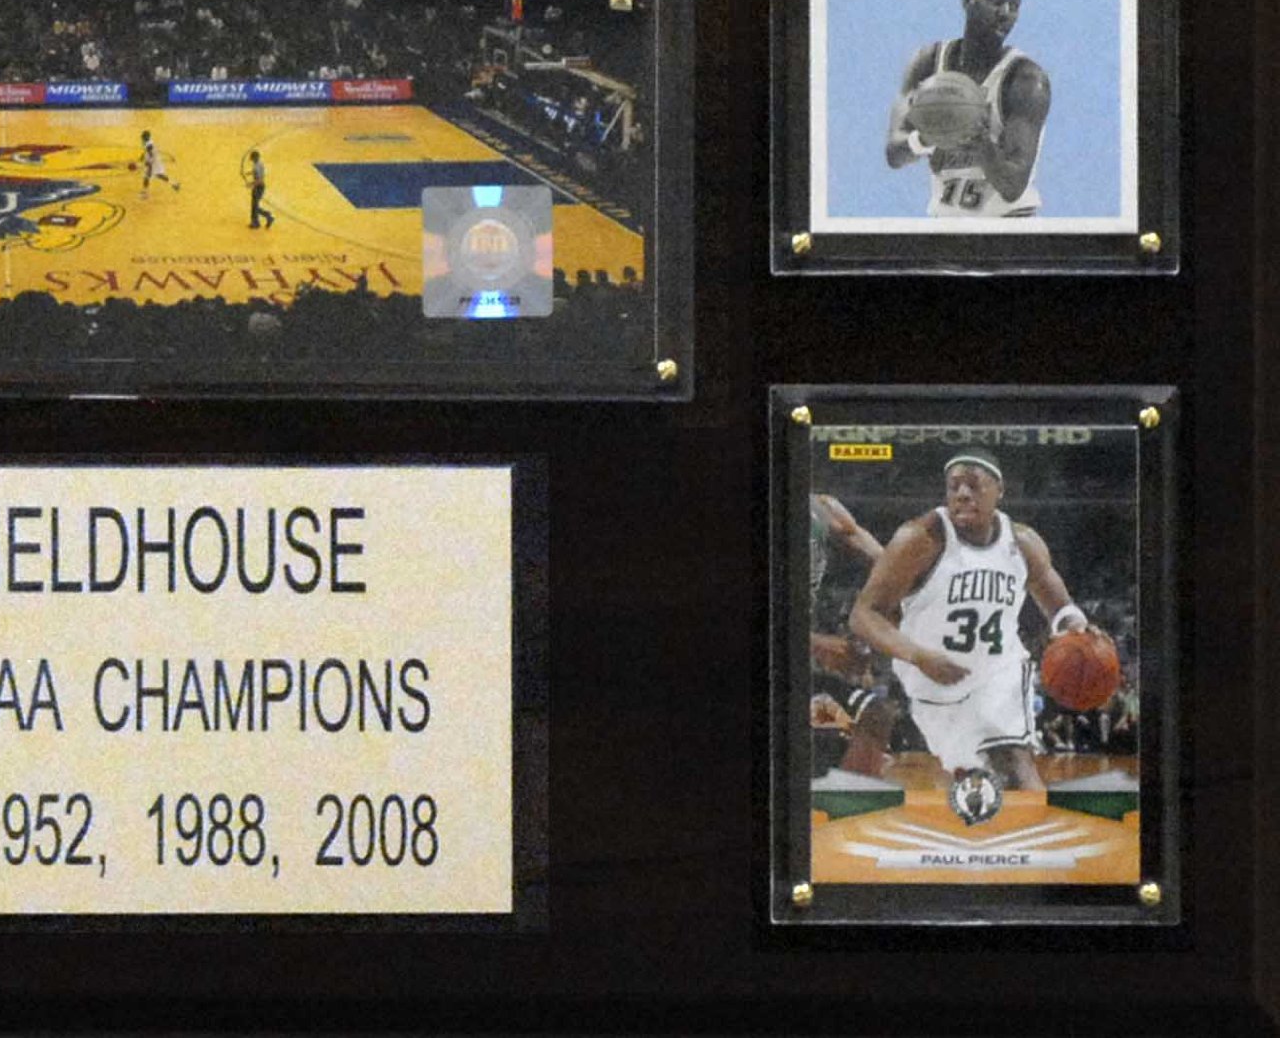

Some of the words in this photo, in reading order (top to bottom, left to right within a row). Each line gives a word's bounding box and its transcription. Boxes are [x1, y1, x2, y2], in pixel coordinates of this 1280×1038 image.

[49, 84, 122, 94] MIDWEST
[174, 83, 246, 93] MIDWEST
[254, 82, 326, 92] MIDWEST
[834, 446, 889, 457] PANINI
[947, 569, 1017, 607] CELTICS
[942, 608, 1004, 655] 34
[93, 657, 431, 733] CHAMPIONS
[148, 792, 279, 877] 1988,
[316, 793, 439, 868] 2008
[921, 854, 965, 864] PAUL
[968, 854, 1030, 865] PIERCE
